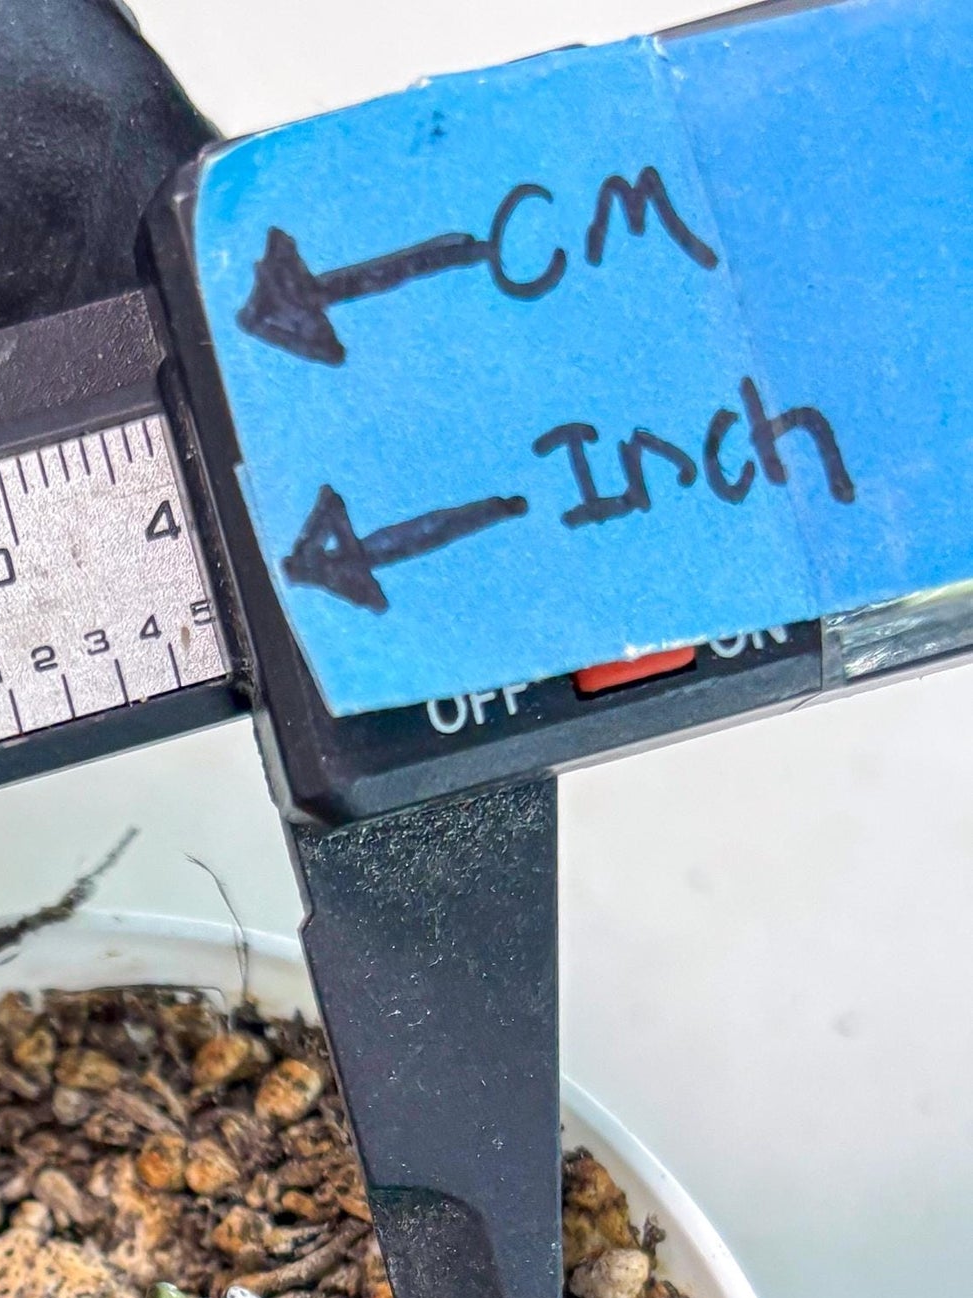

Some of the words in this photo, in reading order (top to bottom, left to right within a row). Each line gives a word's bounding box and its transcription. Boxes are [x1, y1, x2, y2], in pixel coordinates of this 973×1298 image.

[532, 376, 856, 530] Inch
[31, 645, 59, 673] 2
[84, 629, 111, 656] 3
[139, 614, 162, 640] 4
[426, 682, 528, 735] OFF
